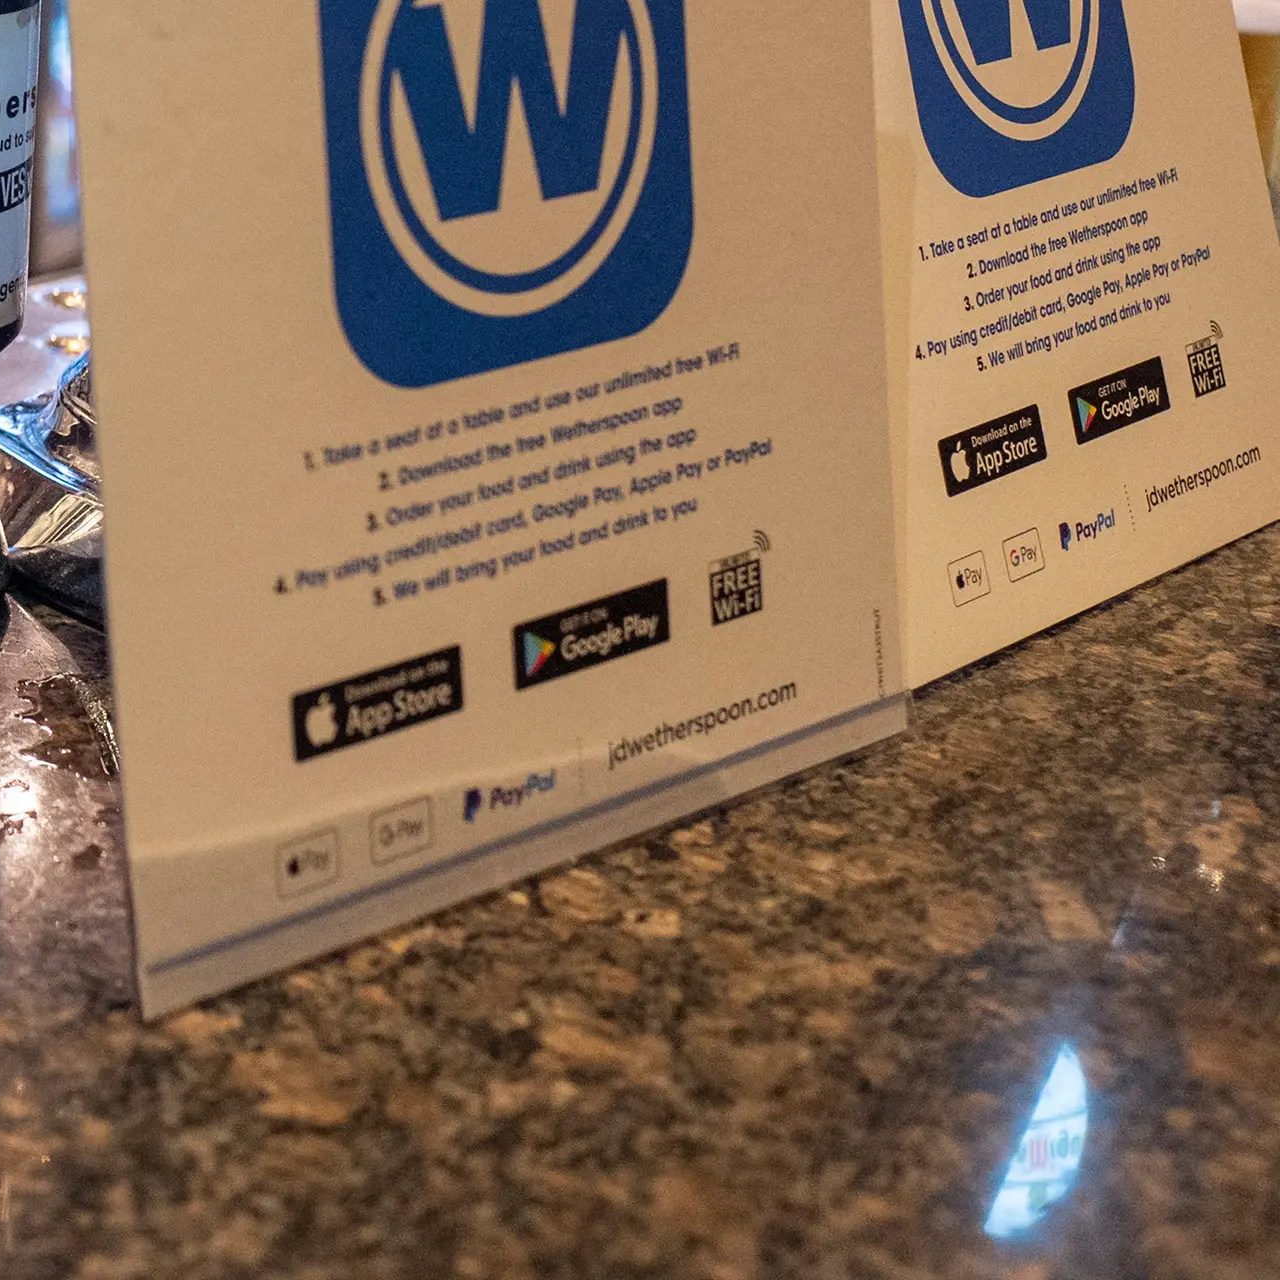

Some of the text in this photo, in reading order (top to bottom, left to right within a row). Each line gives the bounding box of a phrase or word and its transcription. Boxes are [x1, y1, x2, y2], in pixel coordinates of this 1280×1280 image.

[14, 131, 25, 148] to
[918, 168, 1177, 263] 1. Take a seat at a table and use our unlimited free Wi-Fi
[966, 210, 1147, 278] 2. Download the free Wetherspoon app
[964, 236, 1160, 311] 3. Order your food and drink using the app
[915, 246, 1210, 359] 4. Pay using credit/debit card, Google Pay, Apple Pay or PayPal
[976, 293, 1170, 371] 5. We will bring your food and drink to you
[1190, 347, 1219, 374] FREE
[1194, 367, 1223, 394] Wi-Fi
[1102, 386, 1160, 420] Google Play
[971, 424, 1008, 447] Download
[976, 436, 1037, 476] App Store
[1145, 446, 1260, 512] jdwetherspoon.com
[1075, 509, 1115, 541] PayPal
[1020, 546, 1037, 562] Pay
[712, 563, 759, 598] FREE
[964, 568, 982, 587] Pay
[714, 587, 761, 621] Wi-Fi
[560, 623, 624, 661] Google
[623, 613, 659, 640] Play
[606, 679, 798, 769] jdwetherspoon.com
